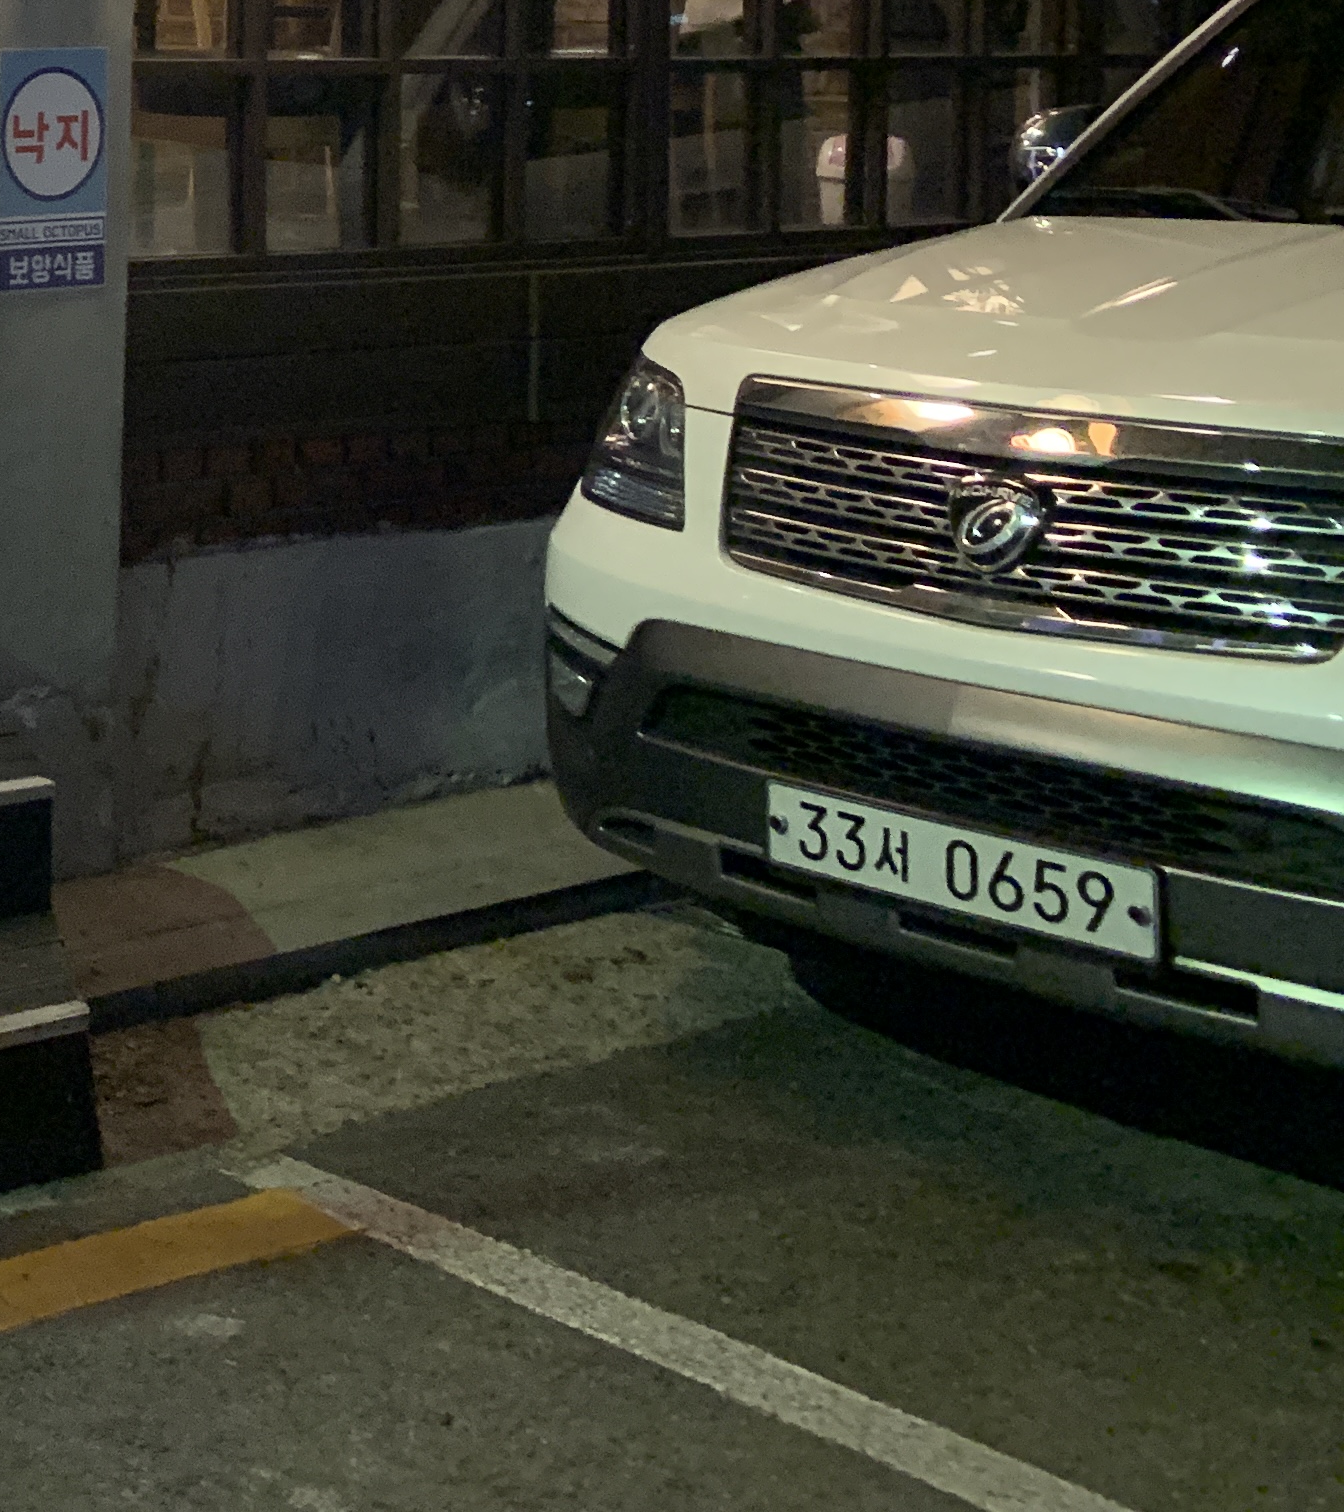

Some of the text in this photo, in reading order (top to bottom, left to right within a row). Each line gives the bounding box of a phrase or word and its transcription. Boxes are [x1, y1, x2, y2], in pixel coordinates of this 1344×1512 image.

[13, 109, 89, 165] 낙지
[0, 221, 101, 240] SMALL OCTOPUS
[9, 250, 95, 286] 보양식품
[798, 801, 1115, 933] 33서 0659
